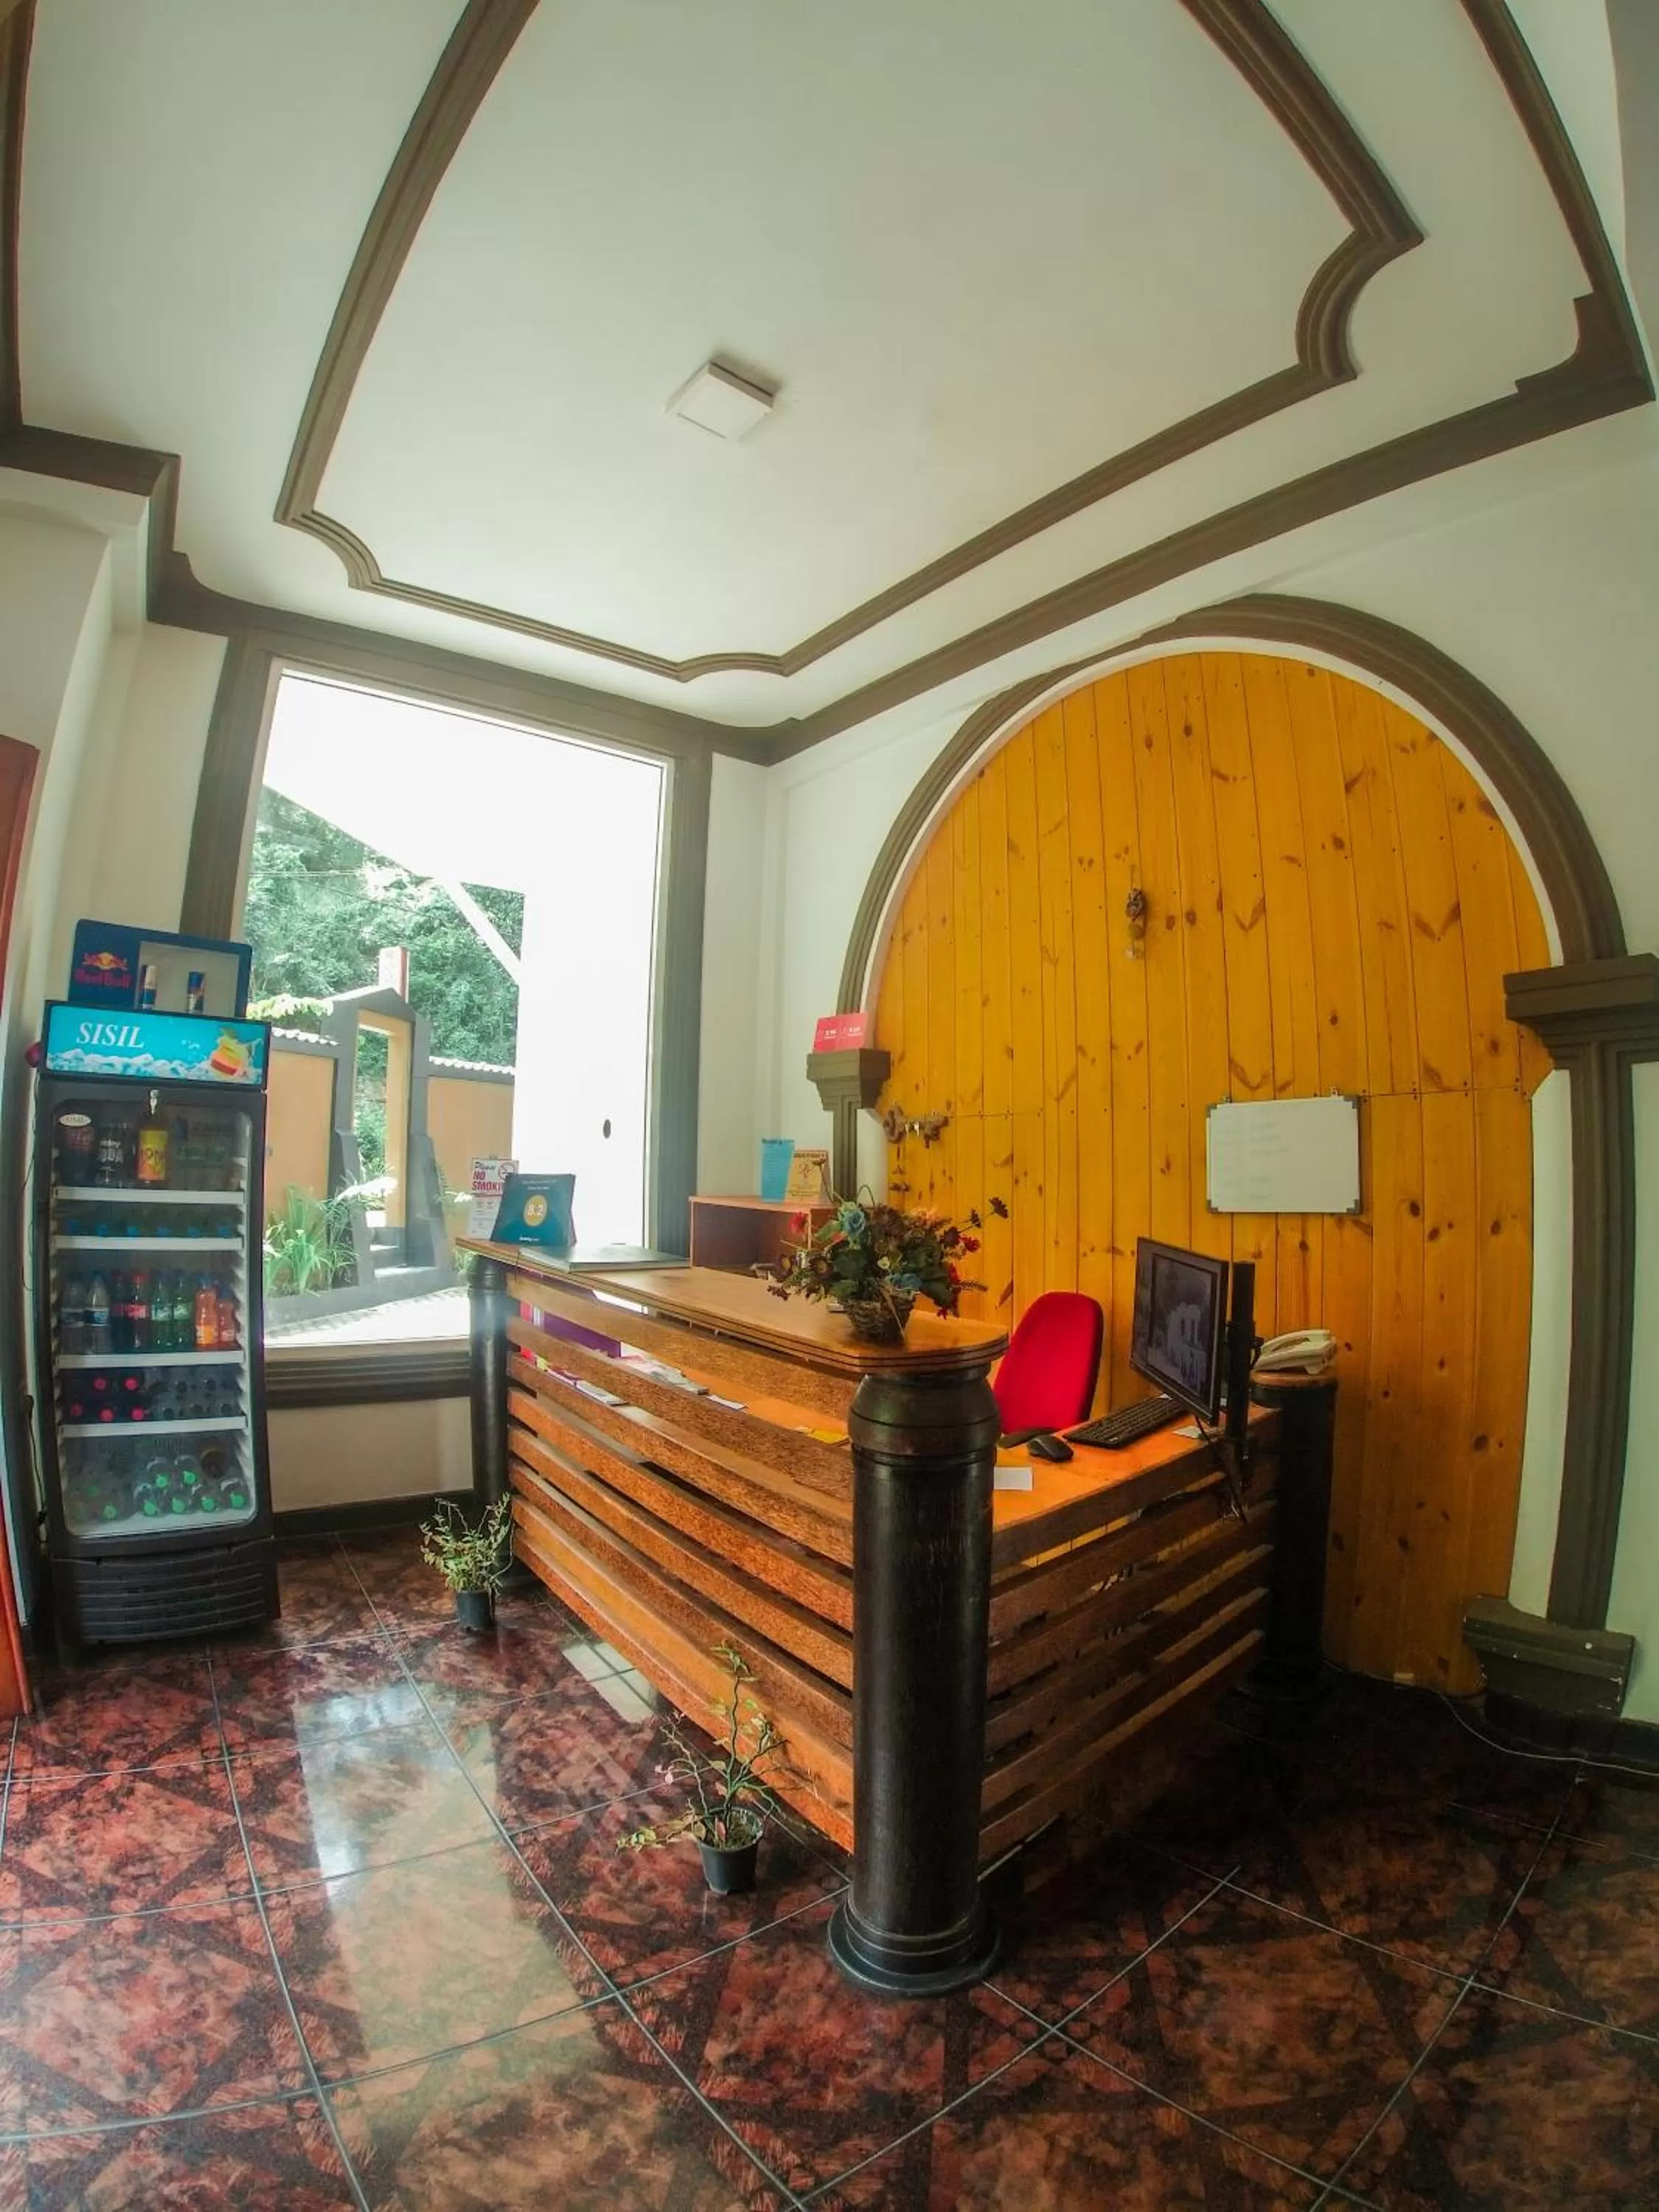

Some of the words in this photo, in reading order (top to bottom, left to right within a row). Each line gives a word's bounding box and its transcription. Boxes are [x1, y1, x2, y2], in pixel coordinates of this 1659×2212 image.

[76, 1022, 145, 1048] SISIL
[473, 1170, 486, 1180] NO
[471, 1180, 501, 1192] SMOKI
